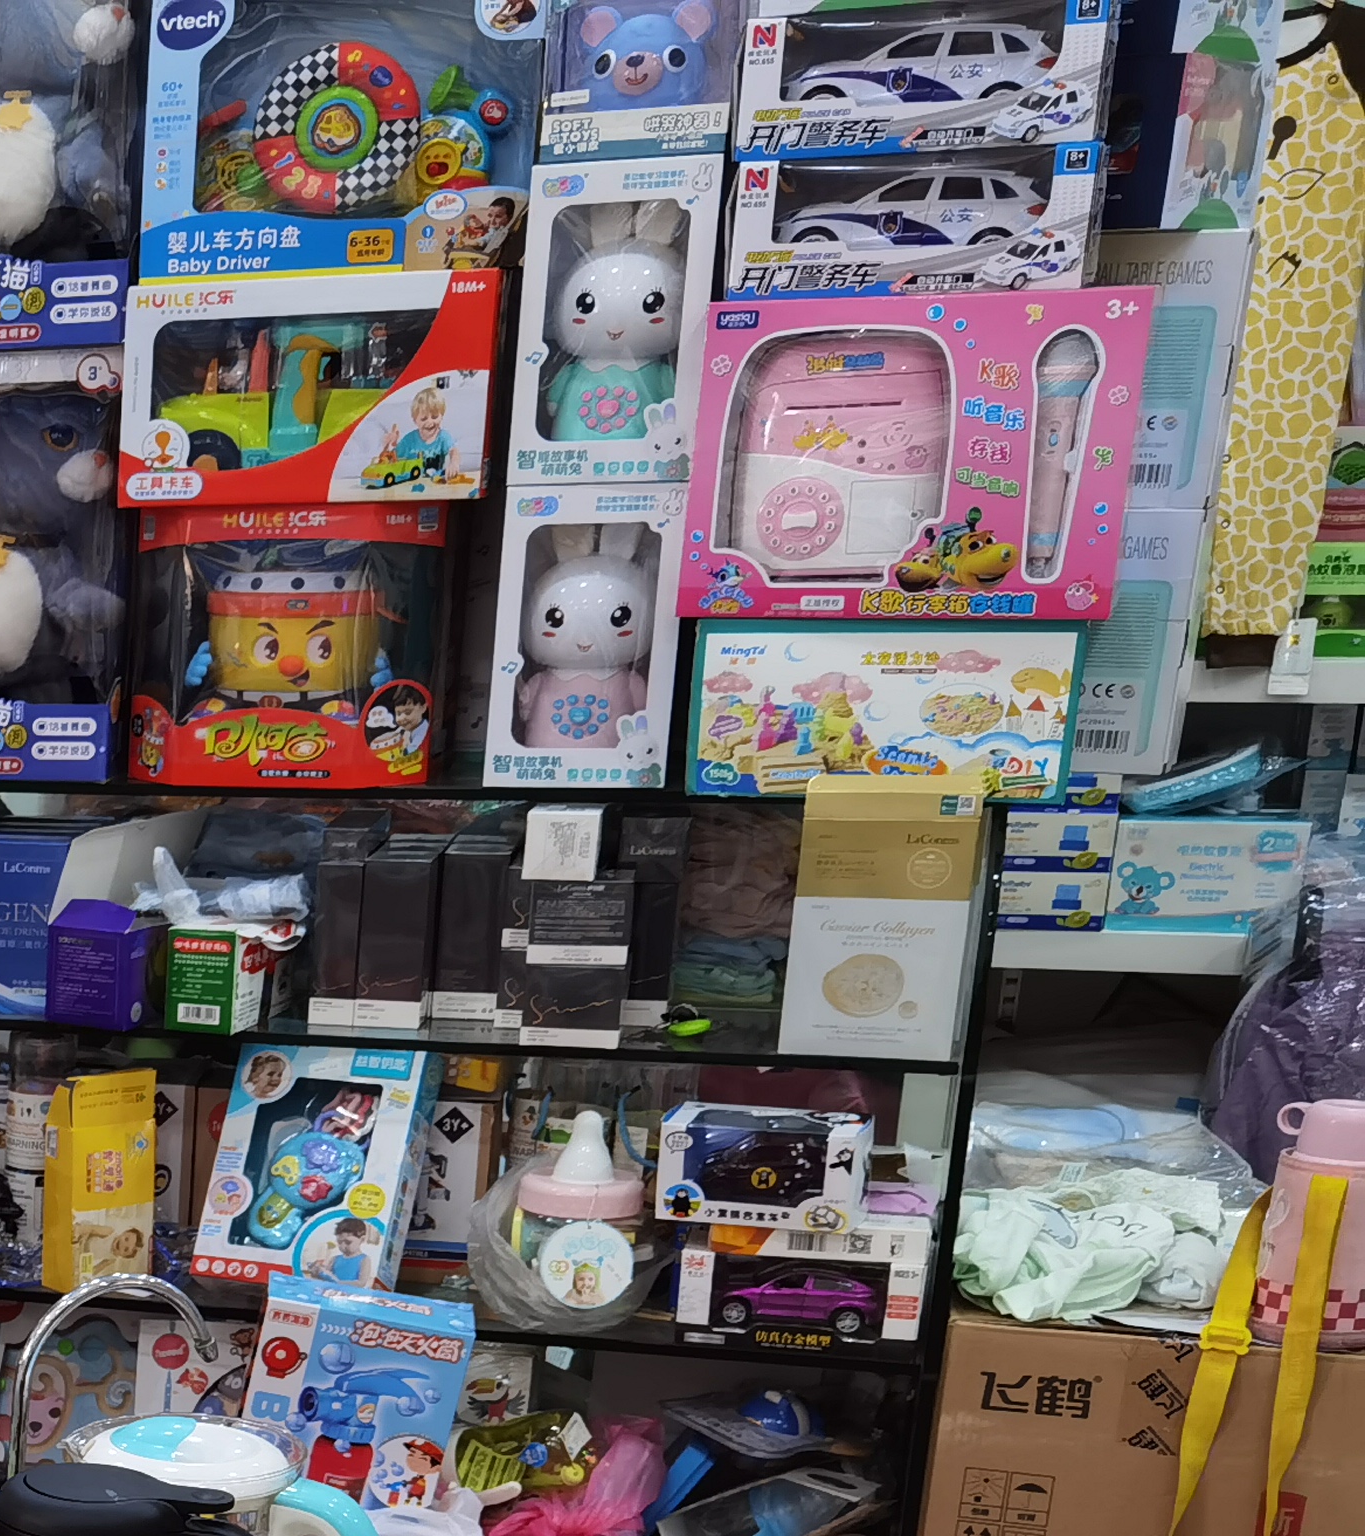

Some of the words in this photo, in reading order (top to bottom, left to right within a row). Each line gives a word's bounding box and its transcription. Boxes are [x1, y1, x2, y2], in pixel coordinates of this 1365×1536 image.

[161, 9, 221, 32] vtech
[949, 62, 983, 79] 公安
[552, 117, 592, 134] SOFT
[561, 129, 599, 143] TOYS
[742, 117, 894, 153] 开门警务车
[939, 206, 974, 225] 公安
[167, 225, 302, 254] 婴儿车方向盘
[167, 257, 212, 277] Baby
[216, 254, 270, 272] Driver
[1121, 262, 1163, 284] TABLE
[1167, 259, 1213, 284] GAMES
[451, 280, 487, 294] 18M+
[732, 261, 881, 294] 开门警务车
[136, 291, 195, 308] HUILE
[1106, 299, 1140, 316] 3+
[978, 359, 1021, 390] K歌
[963, 398, 1026, 431] 听音乐
[969, 438, 1011, 464] 存钱
[136, 475, 194, 490] 工具卡车
[955, 468, 1020, 497] 可当音响
[222, 510, 284, 528] HUILE
[859, 589, 1036, 615] K歌行李箱存钱罐
[872, 918, 936, 937] Collagen
[353, 1318, 461, 1363] 泡泡灭火筒
[755, 1329, 832, 1347] 仿真合金模型
[980, 1370, 1093, 1420] 飞鹤
